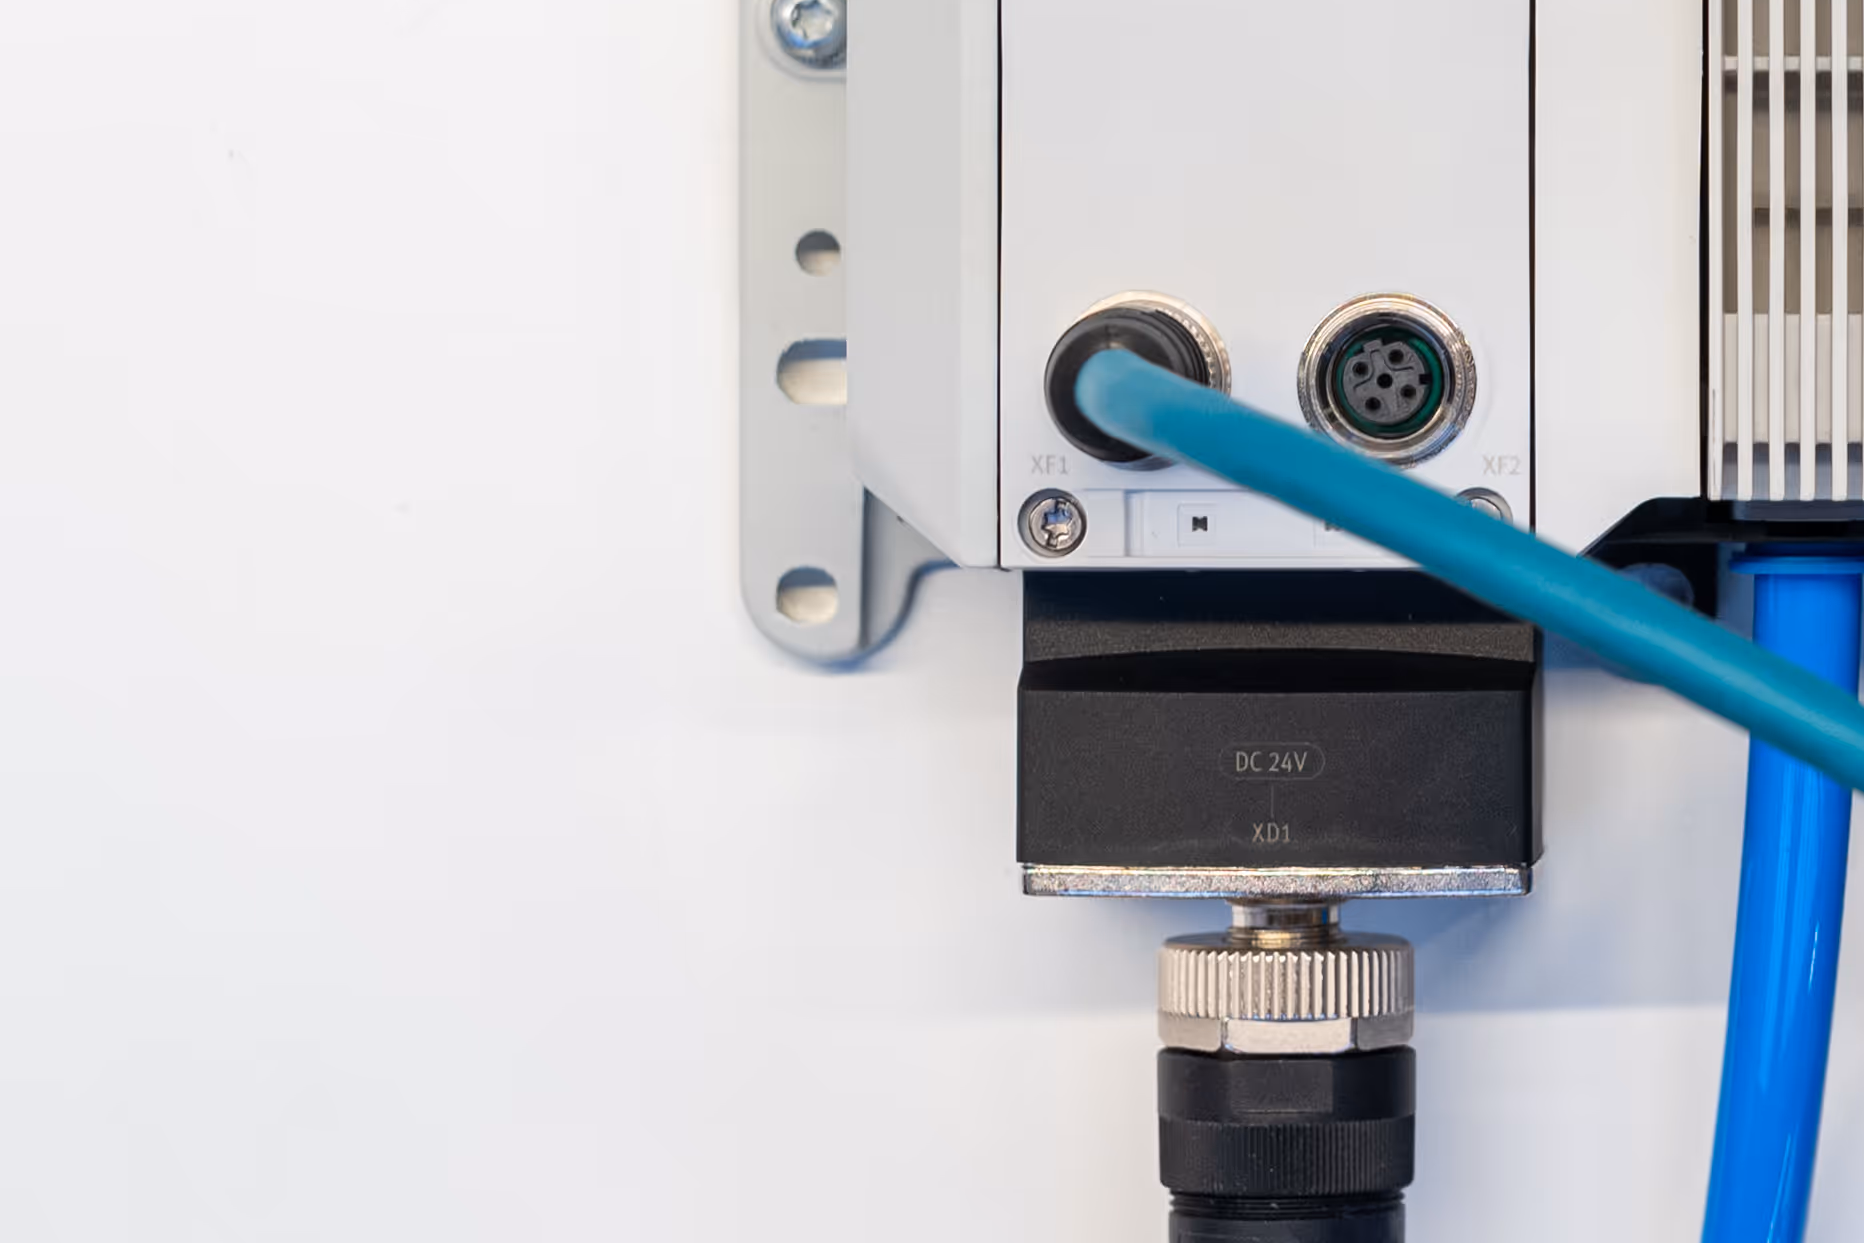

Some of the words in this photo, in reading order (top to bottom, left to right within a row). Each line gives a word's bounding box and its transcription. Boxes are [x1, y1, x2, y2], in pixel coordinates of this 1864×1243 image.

[1031, 456, 1069, 475] XF1
[1482, 457, 1522, 476] XF2
[1236, 751, 1262, 772] DC
[1268, 751, 1308, 773] 24V
[1252, 822, 1290, 843] XD1
